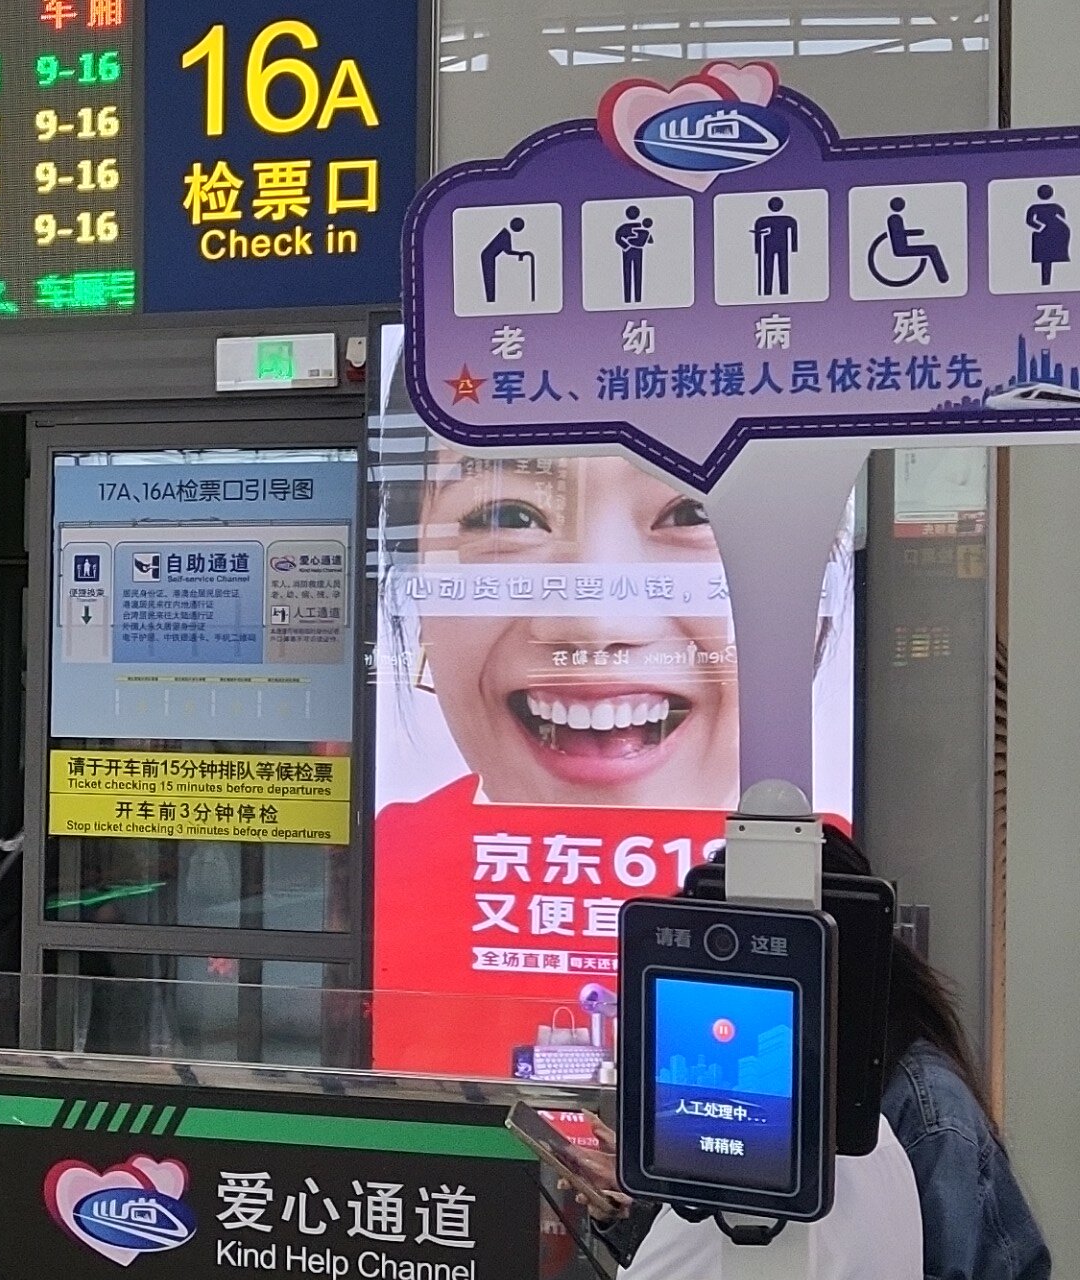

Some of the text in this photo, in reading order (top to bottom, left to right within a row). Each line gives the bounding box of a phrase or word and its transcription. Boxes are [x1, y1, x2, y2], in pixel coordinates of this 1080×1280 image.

[36, 51, 120, 88] 9-16
[182, 19, 380, 136] 16A
[35, 106, 119, 141] 9-16
[34, 159, 119, 195] 9-16
[183, 158, 379, 225] 检票口
[34, 212, 117, 246] 9-16
[200, 224, 357, 261] Check in
[490, 303, 1072, 361] 老 幼 病 残 孕
[490, 353, 984, 405] 军人、消防救援人员依法优先
[98, 478, 314, 504] 17A、16A检票口引导图
[167, 552, 250, 573] 自助通道
[67, 756, 333, 784] 请于开车前15分钟排队等候检票
[67, 778, 332, 797] Ticket checking 15 minutes before departures
[115, 801, 278, 825] 开车前3分钟停检
[66, 820, 331, 840] Stop ticket checking 3 minutes before departures
[655, 926, 788, 956] 请看 这里
[482, 951, 560, 969] 全场直降
[699, 1135, 745, 1157] 请稍候
[216, 1171, 477, 1249] 爱心通道
[217, 1238, 276, 1271] Kind
